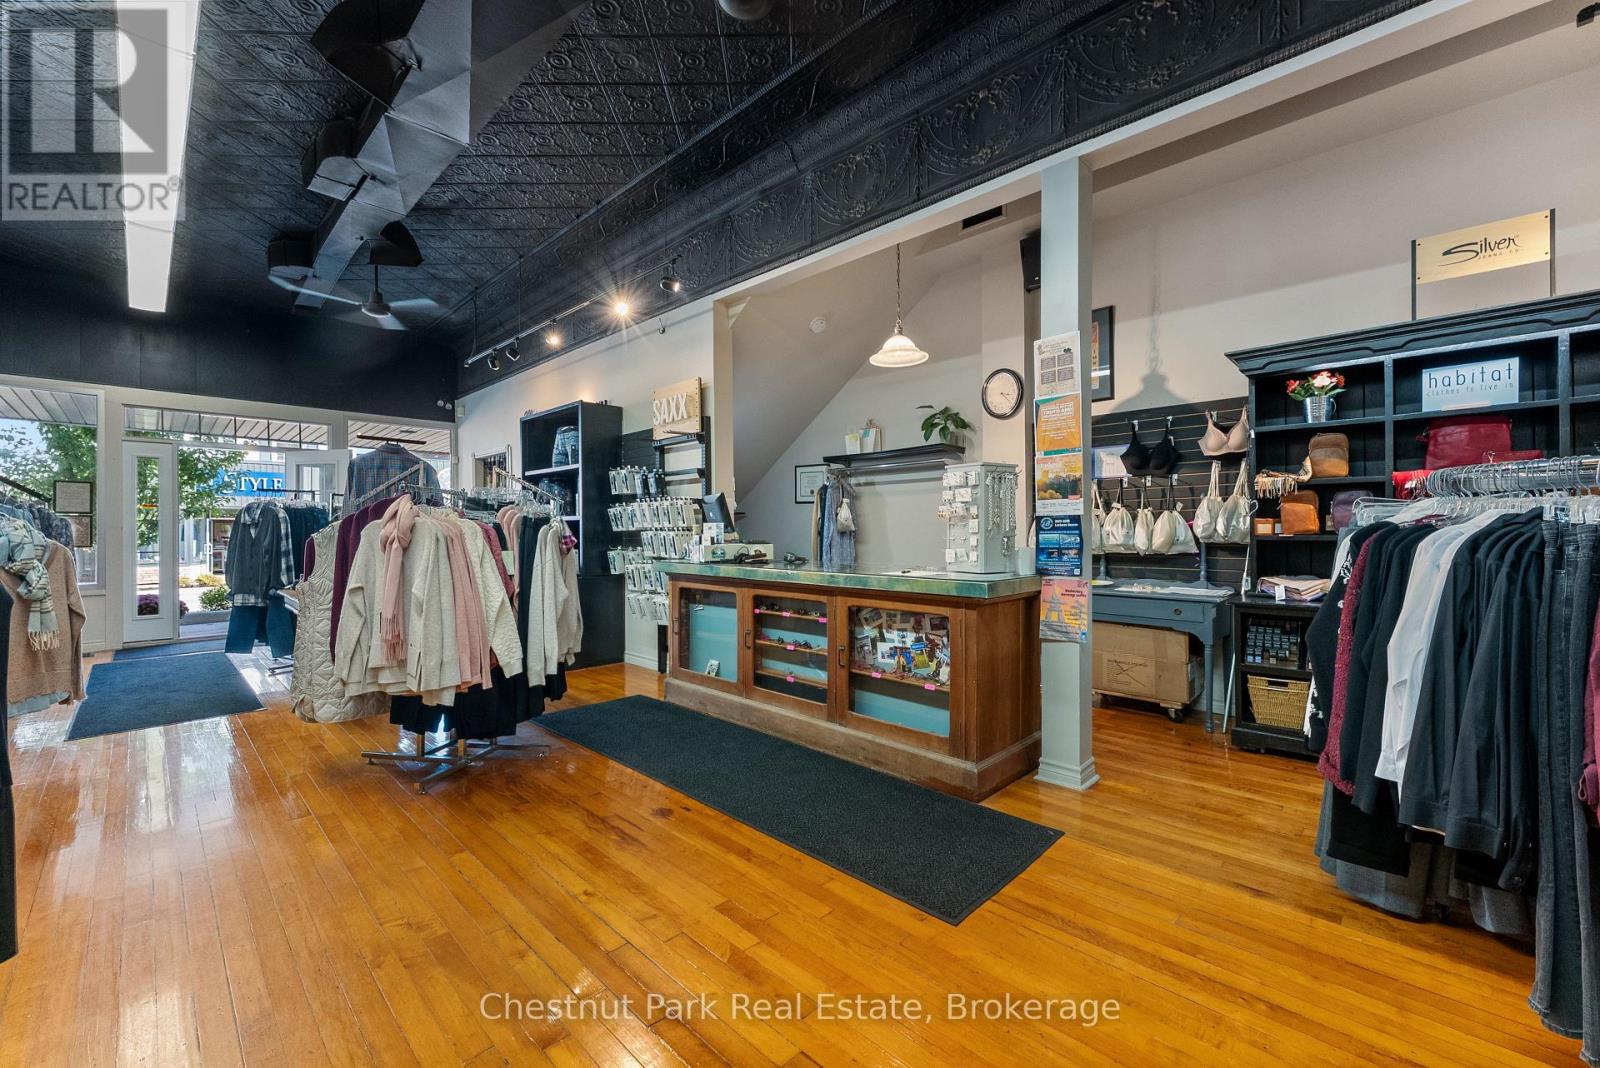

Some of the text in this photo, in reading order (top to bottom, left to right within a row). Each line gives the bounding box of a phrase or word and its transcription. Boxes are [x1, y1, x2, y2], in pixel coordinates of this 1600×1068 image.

[1438, 236, 1520, 267] Silver
[1428, 362, 1513, 389] habitat
[653, 391, 688, 426] SAXX
